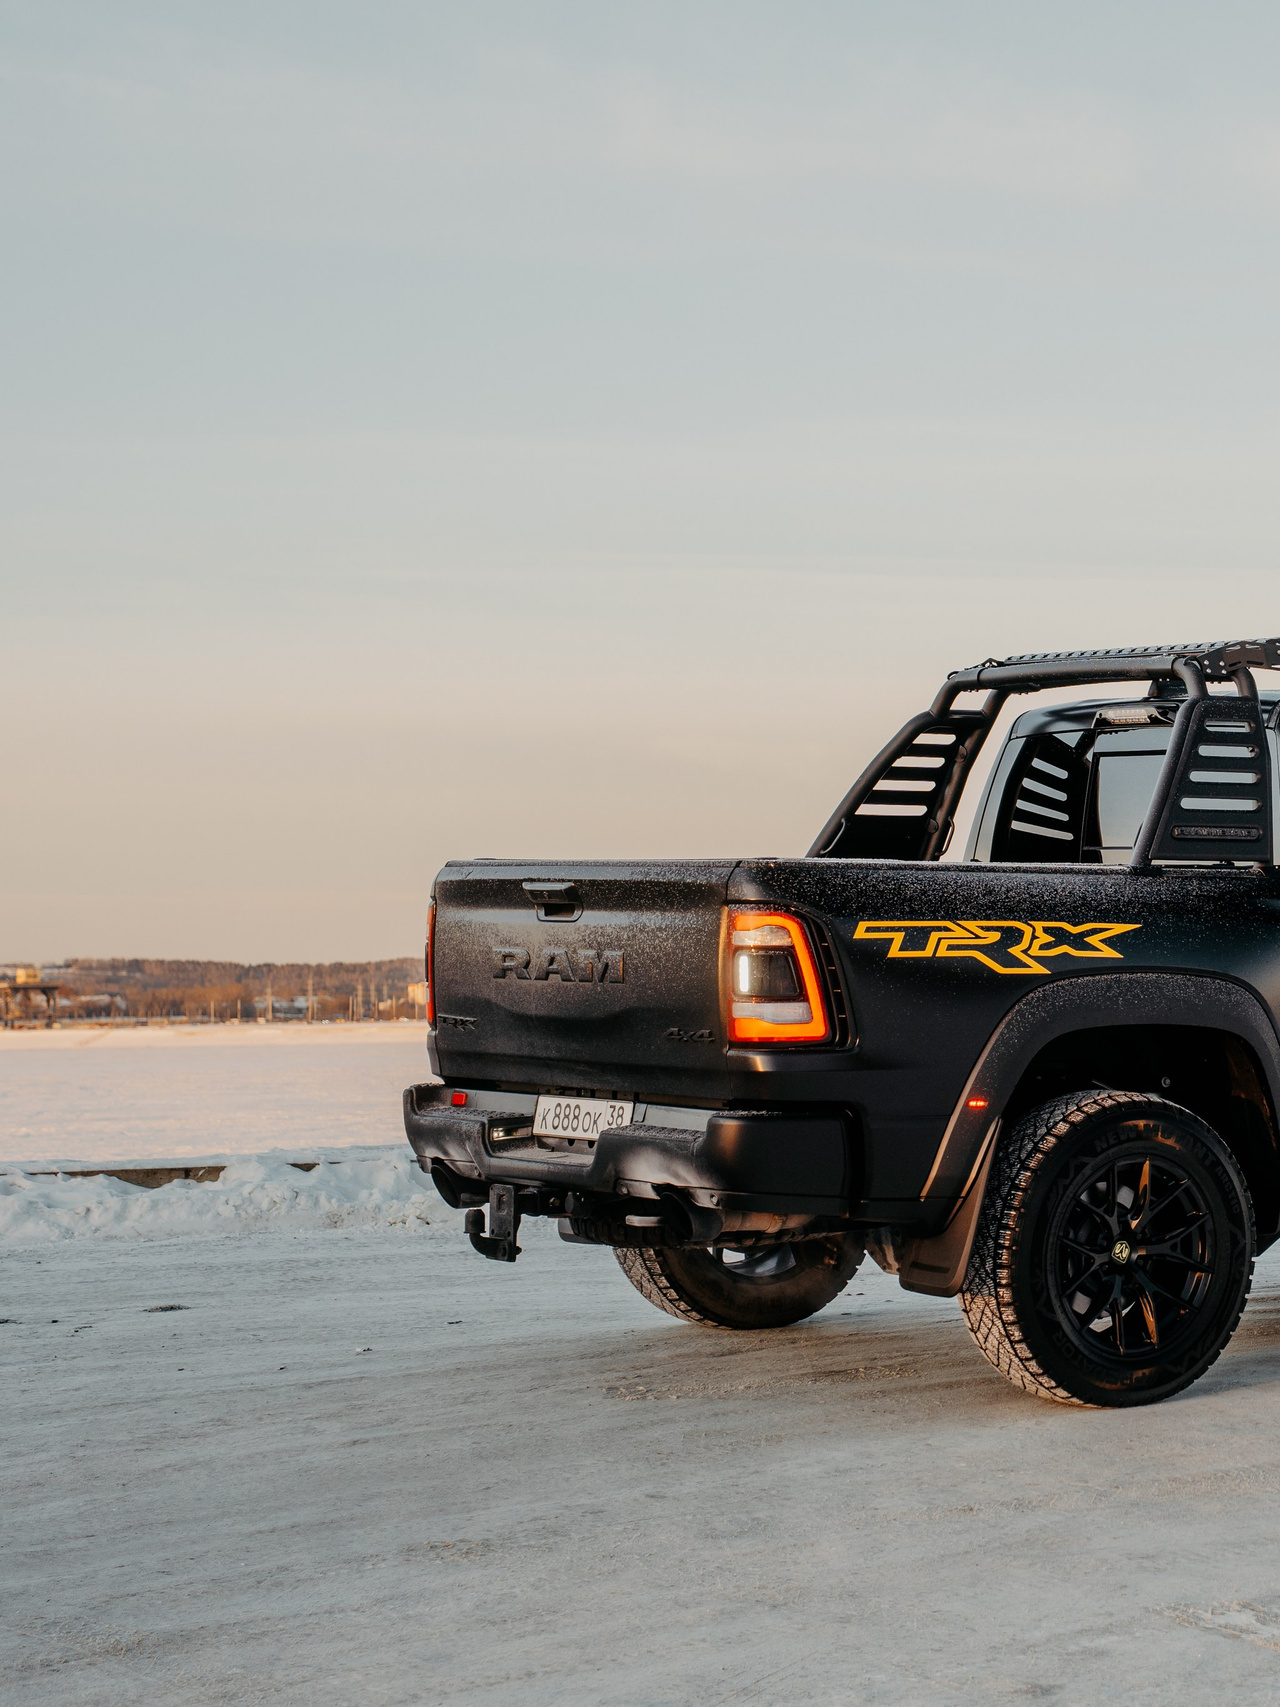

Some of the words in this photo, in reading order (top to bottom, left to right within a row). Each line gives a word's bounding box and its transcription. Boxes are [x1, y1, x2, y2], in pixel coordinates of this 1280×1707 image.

[853, 921, 1142, 974] TRX
[492, 948, 625, 984] RAM
[607, 1104, 624, 1127] 38
